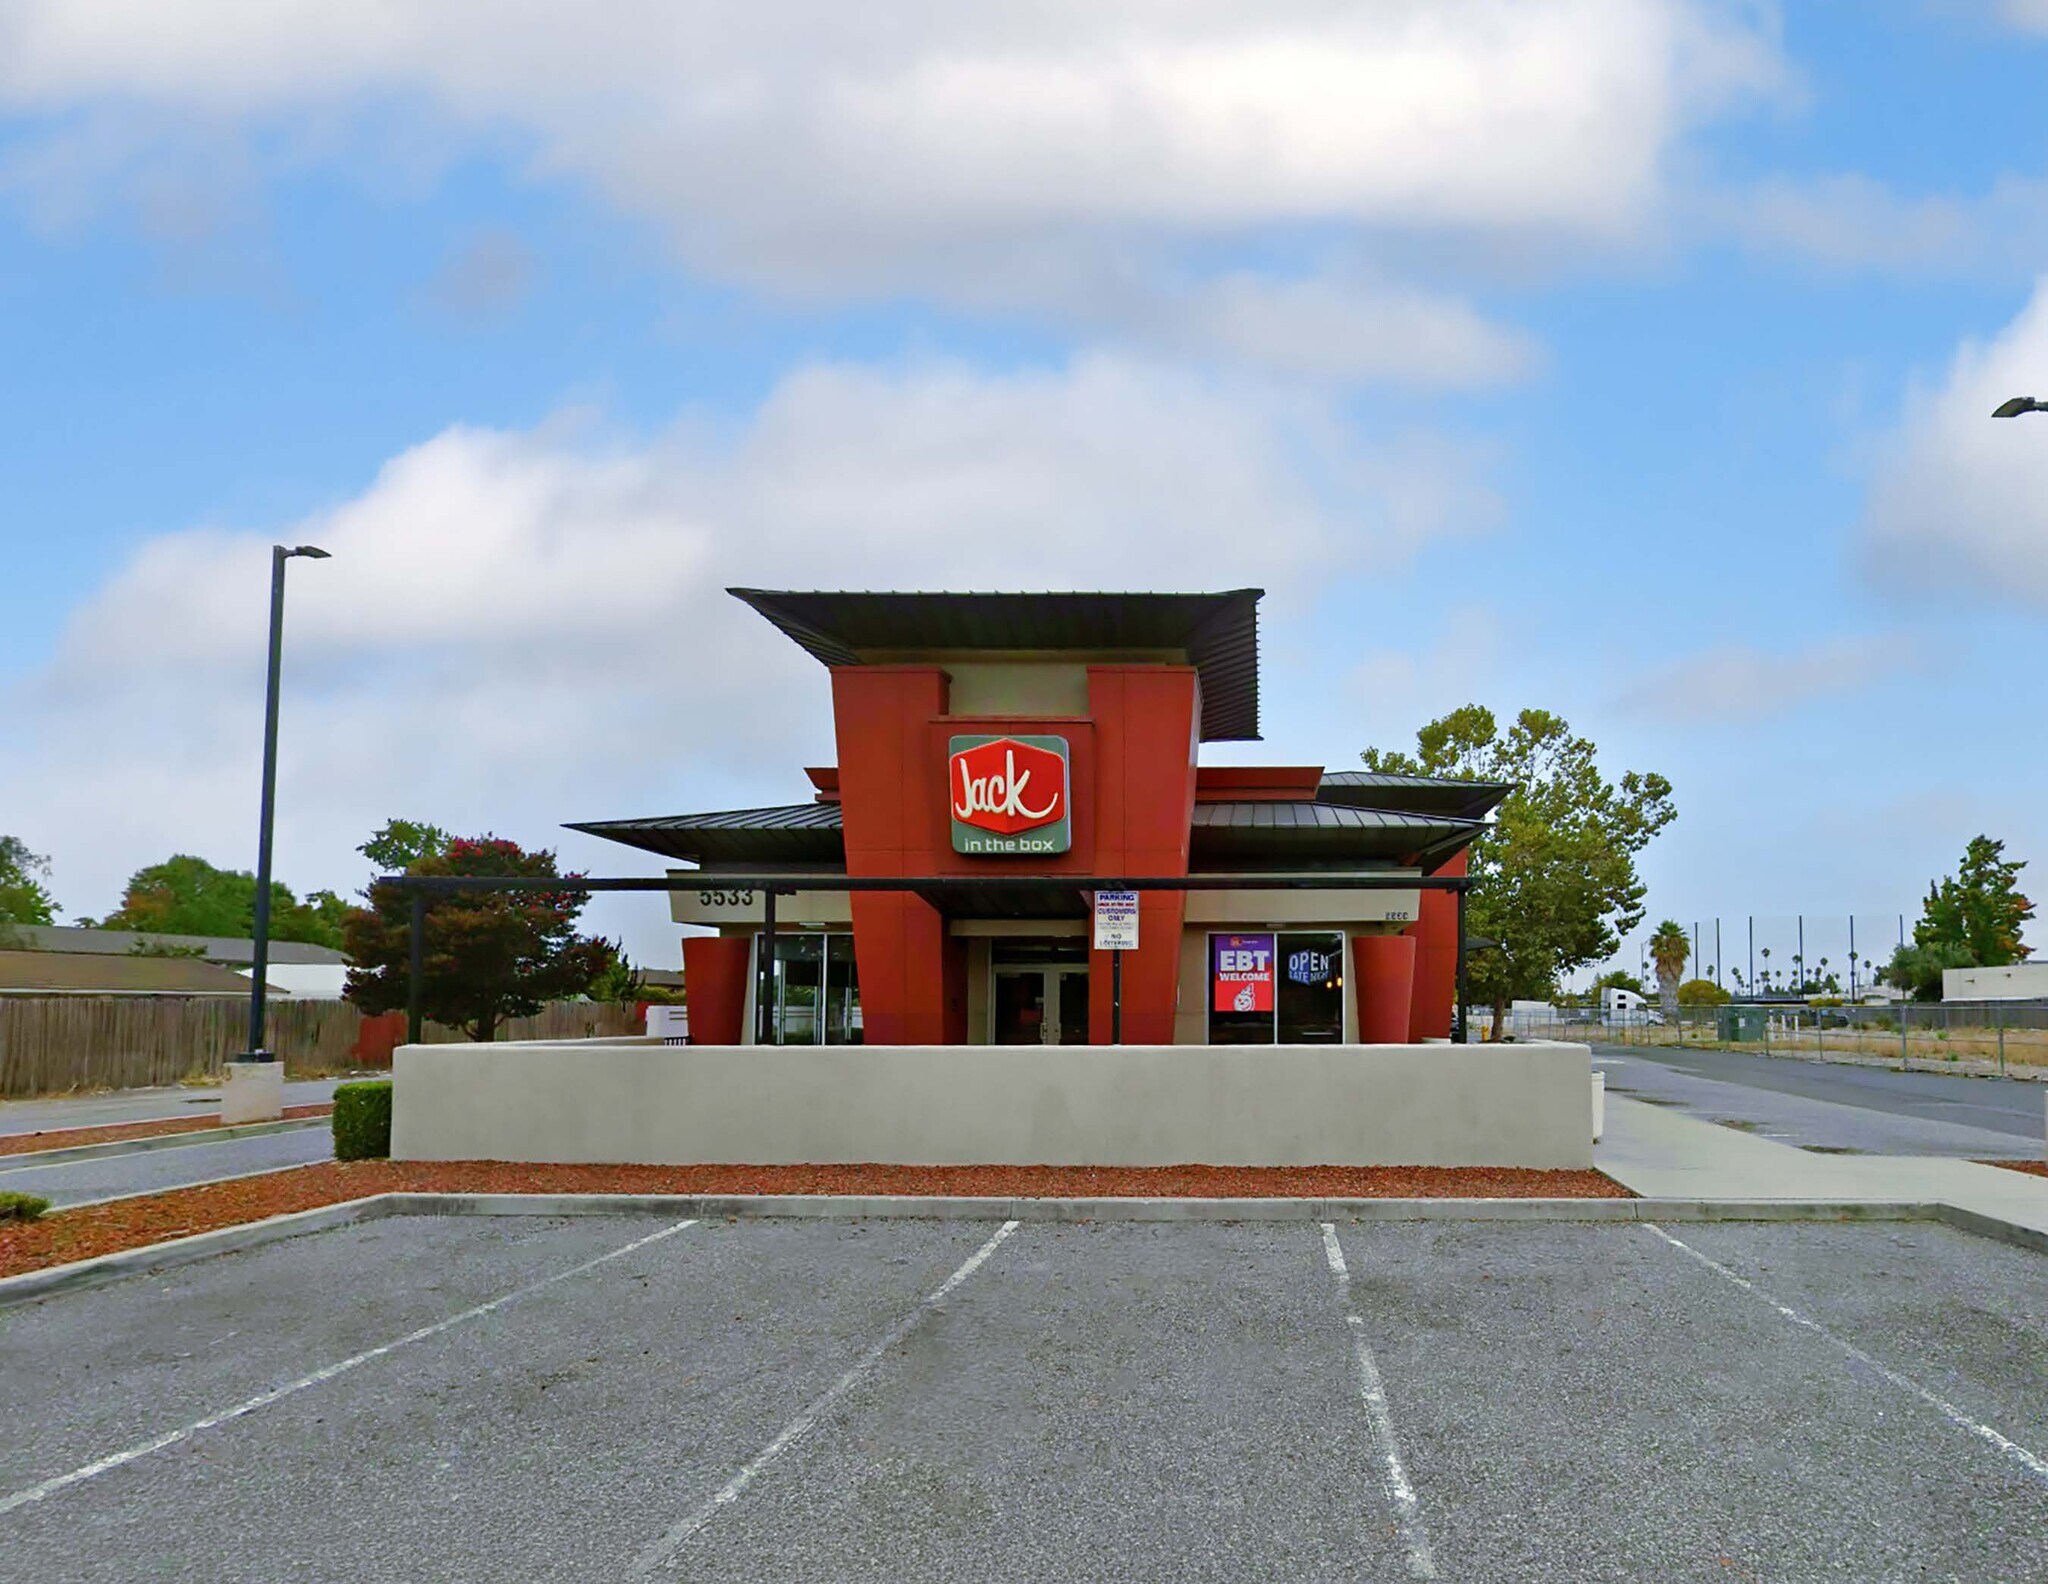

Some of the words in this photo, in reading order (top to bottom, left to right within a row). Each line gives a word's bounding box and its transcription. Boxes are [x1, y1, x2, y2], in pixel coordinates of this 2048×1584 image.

[955, 749, 1058, 818] Jack
[964, 838, 981, 851] in
[985, 838, 1016, 851] the
[1020, 838, 1053, 851] box
[699, 889, 753, 906] 5533
[1220, 950, 1270, 971] EBT
[1289, 951, 1329, 971] OPEN
[1219, 973, 1270, 981] WELCOME
